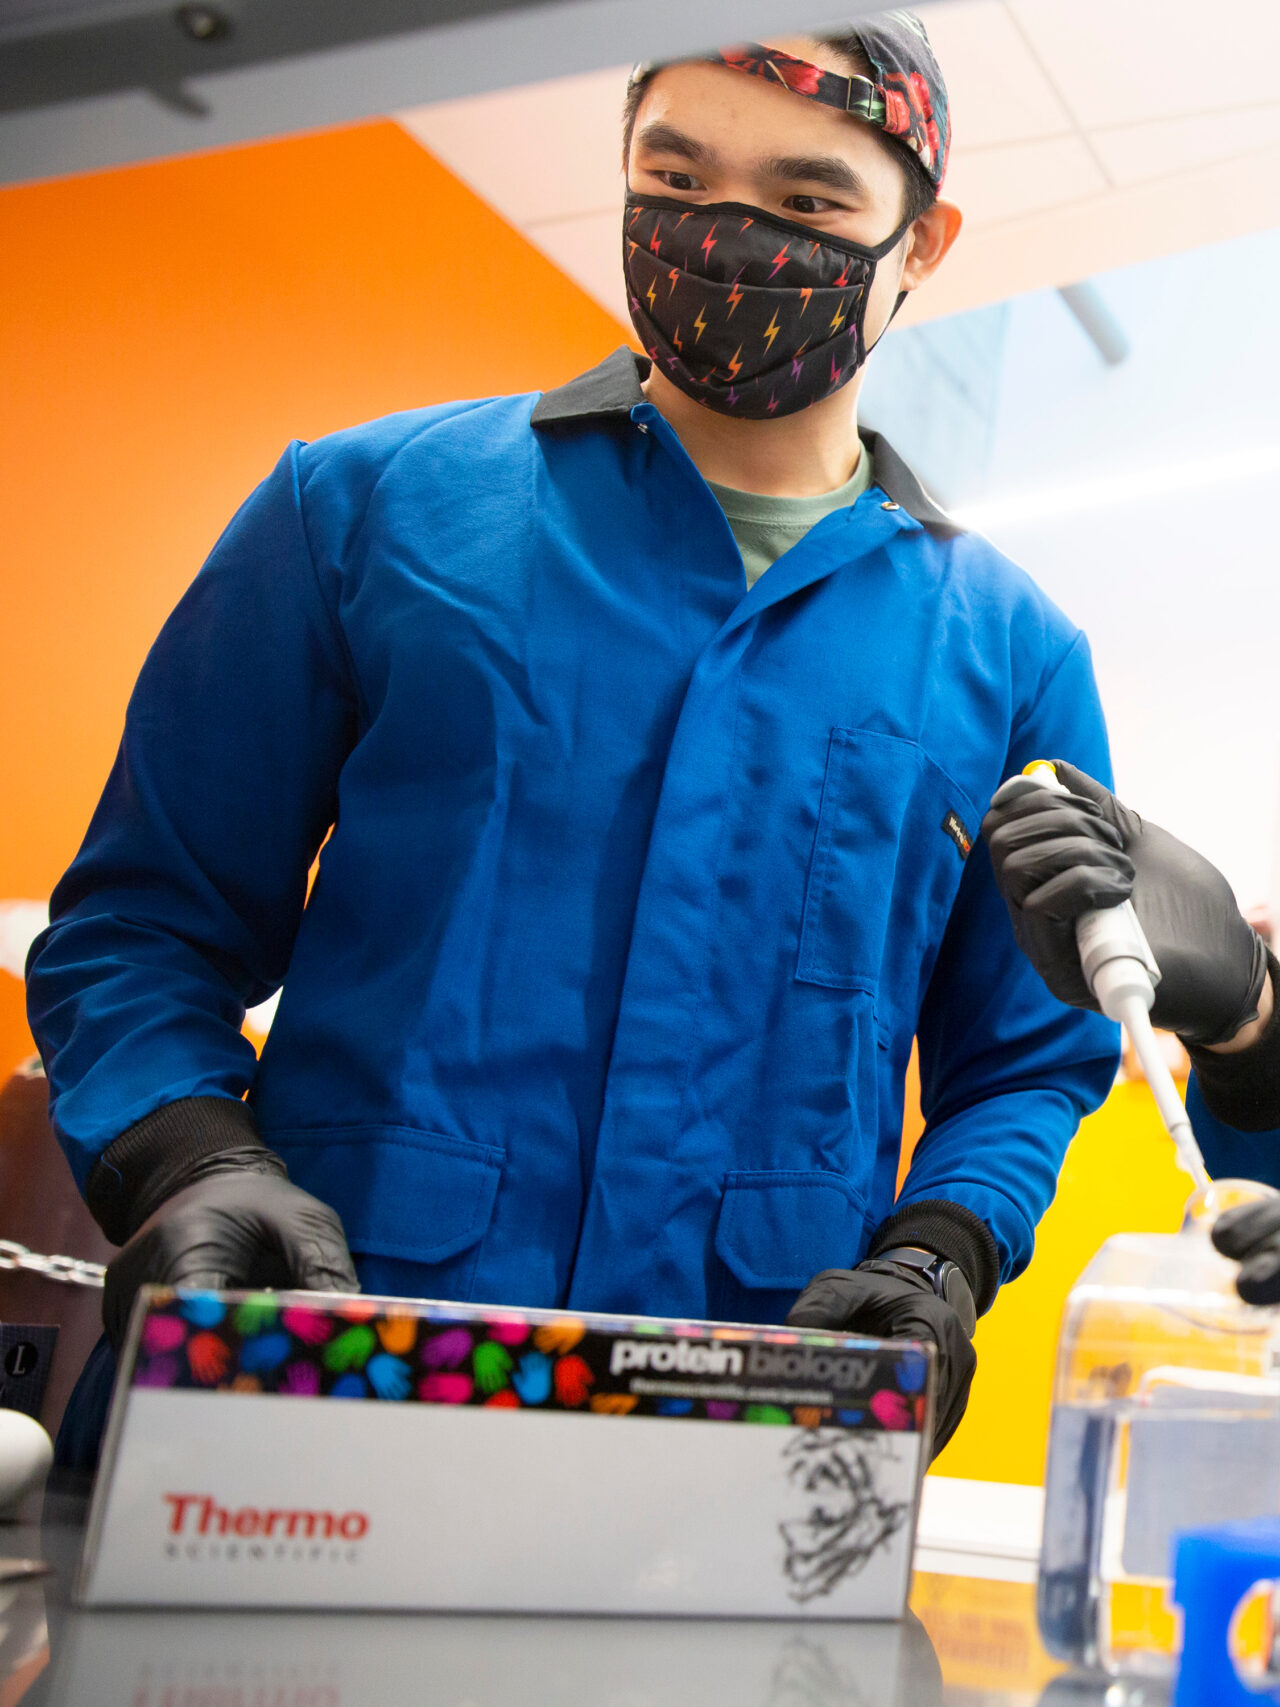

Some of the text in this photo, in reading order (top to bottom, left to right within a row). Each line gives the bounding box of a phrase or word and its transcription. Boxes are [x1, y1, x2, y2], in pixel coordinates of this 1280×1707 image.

[610, 1340, 877, 1388] protein biology
[162, 1491, 370, 1541] Thermo
